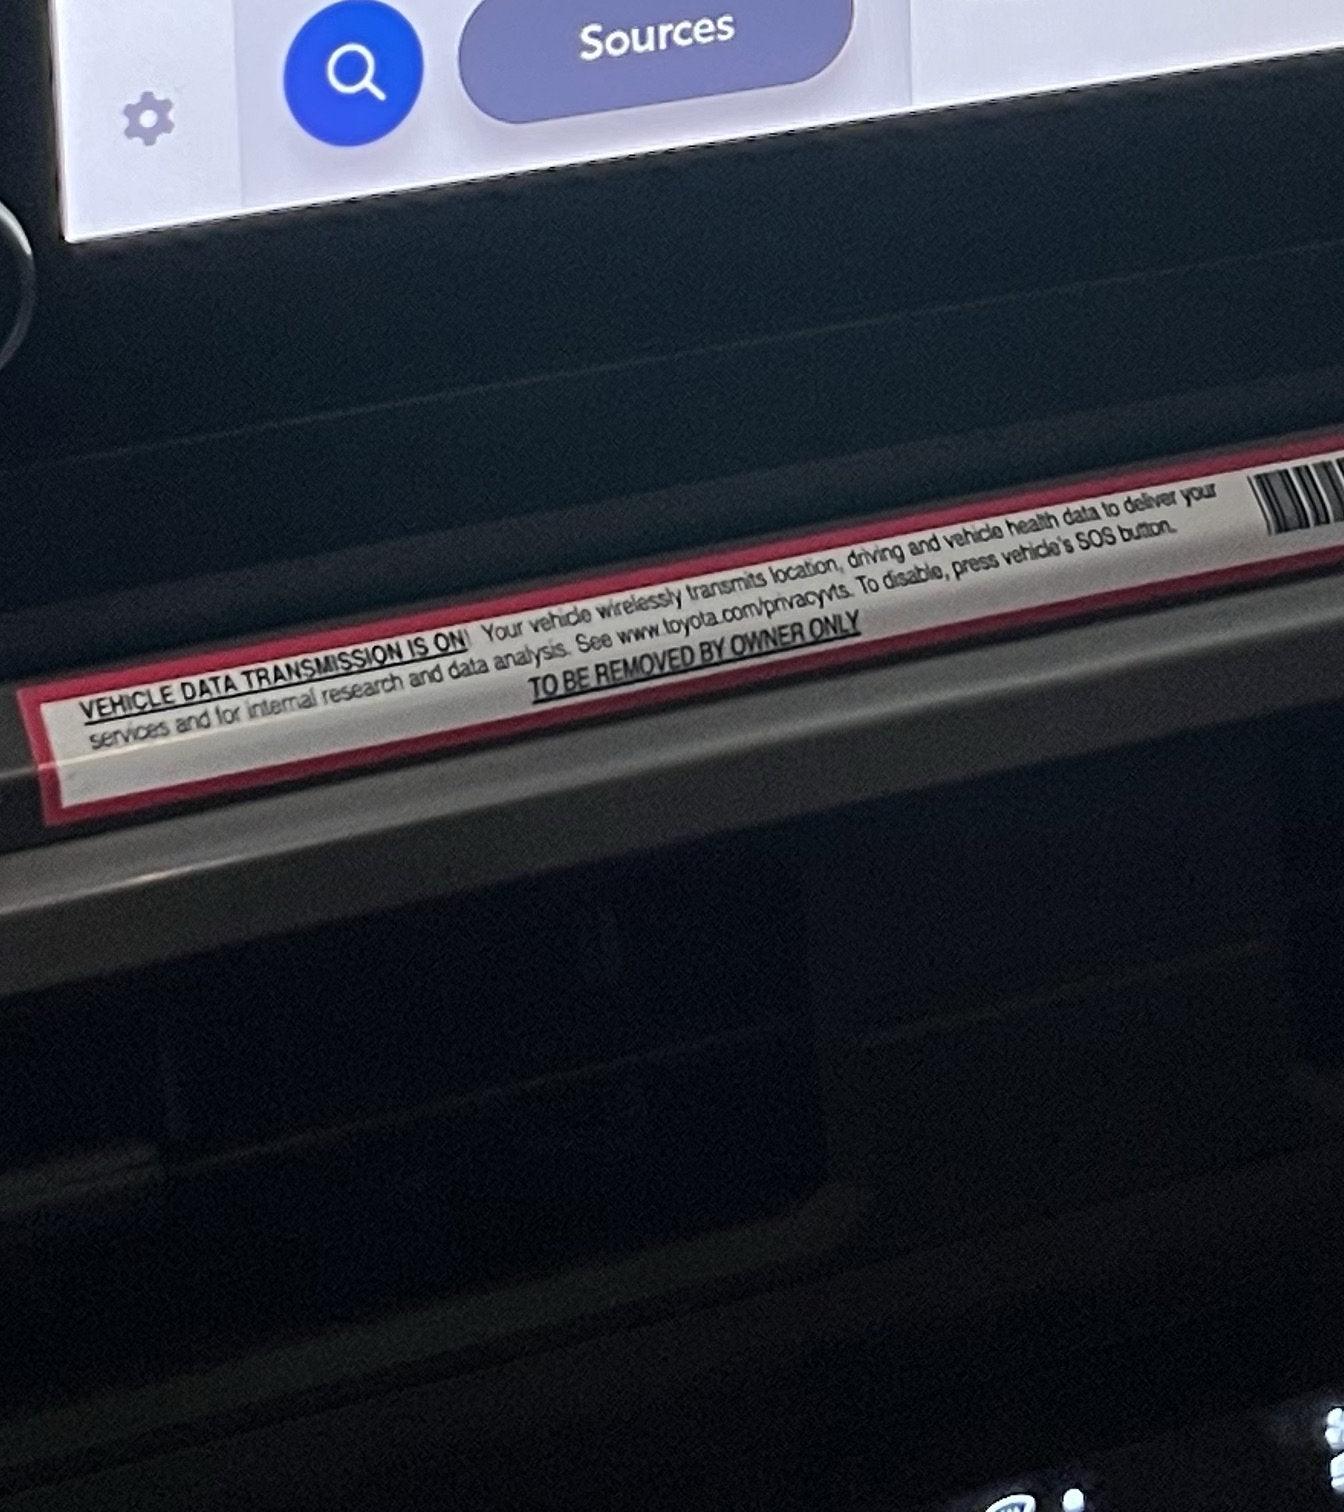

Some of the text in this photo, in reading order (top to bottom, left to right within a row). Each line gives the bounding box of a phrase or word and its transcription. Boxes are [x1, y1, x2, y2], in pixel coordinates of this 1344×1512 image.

[579, 10, 736, 63] Sources
[78, 685, 176, 720] VEHICLE
[181, 674, 237, 702] DATA
[240, 641, 404, 690] TRANSMISSION
[407, 636, 430, 658] IS
[480, 620, 523, 643] Your
[529, 605, 592, 634] vehicle
[595, 586, 683, 620] wirelessly
[685, 571, 768, 601] transmits
[768, 557, 844, 584] location,
[847, 542, 905, 569] driving
[908, 533, 942, 557] and
[943, 523, 1004, 549] vehicle
[1005, 510, 1060, 536] health
[1062, 502, 1102, 527] data
[1103, 500, 1121, 519] to
[1123, 489, 1178, 514] deliver
[1179, 483, 1218, 508] your
[89, 720, 172, 750] services
[175, 708, 211, 734] and
[215, 703, 242, 726] for
[246, 687, 317, 719] internal
[322, 672, 405, 705] research
[409, 664, 444, 688] and
[448, 656, 489, 680] data
[575, 632, 613, 654] See
[855, 574, 879, 595] To
[882, 561, 950, 591] disable,
[951, 552, 1000, 581] press
[1000, 535, 1075, 565] vehicle's
[1075, 526, 1117, 551] SOS
[1116, 518, 1177, 543] button.
[528, 607, 861, 700] TO BE REMOVED BY OWNER ONLY
